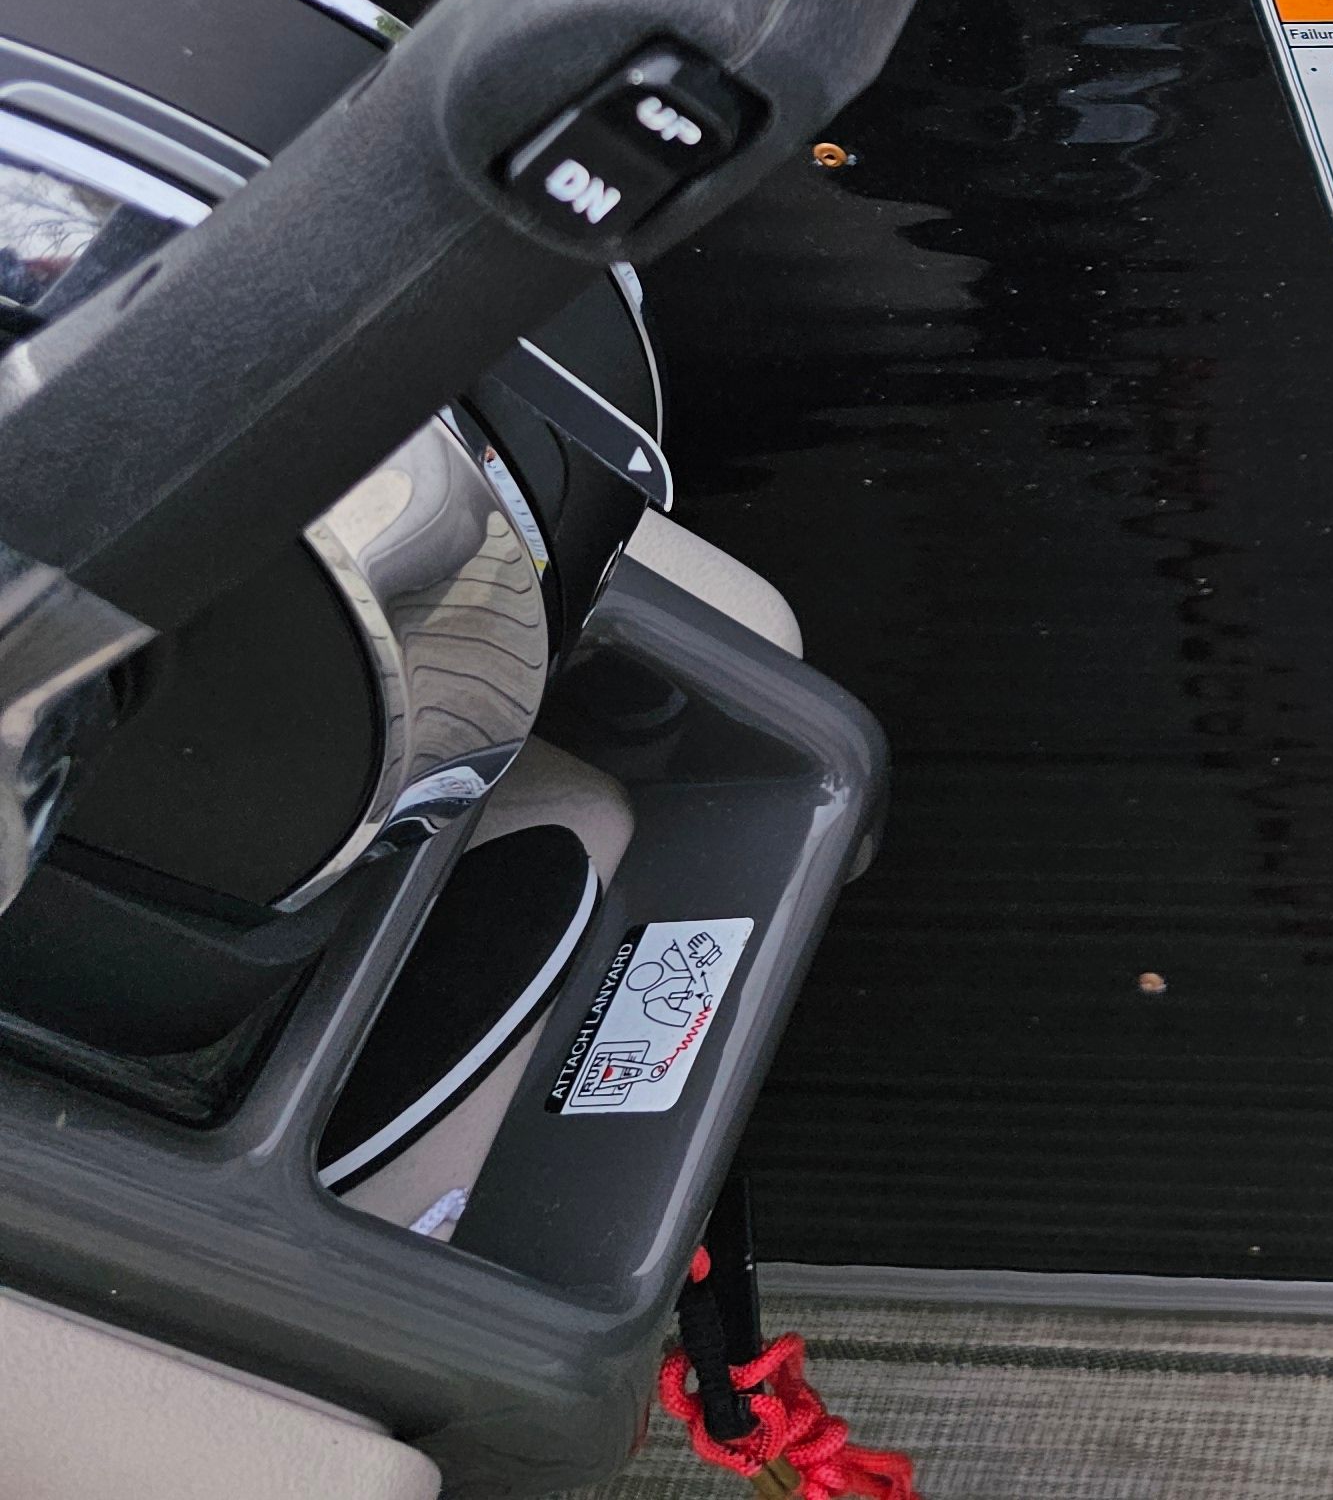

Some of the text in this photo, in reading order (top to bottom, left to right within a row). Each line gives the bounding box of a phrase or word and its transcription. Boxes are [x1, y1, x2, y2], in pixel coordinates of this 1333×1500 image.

[636, 96, 702, 145] UP
[545, 158, 621, 224] DN
[551, 1029, 595, 1100] ATTACH
[586, 943, 633, 1025] LANYARD
[579, 1055, 608, 1094] RUN
